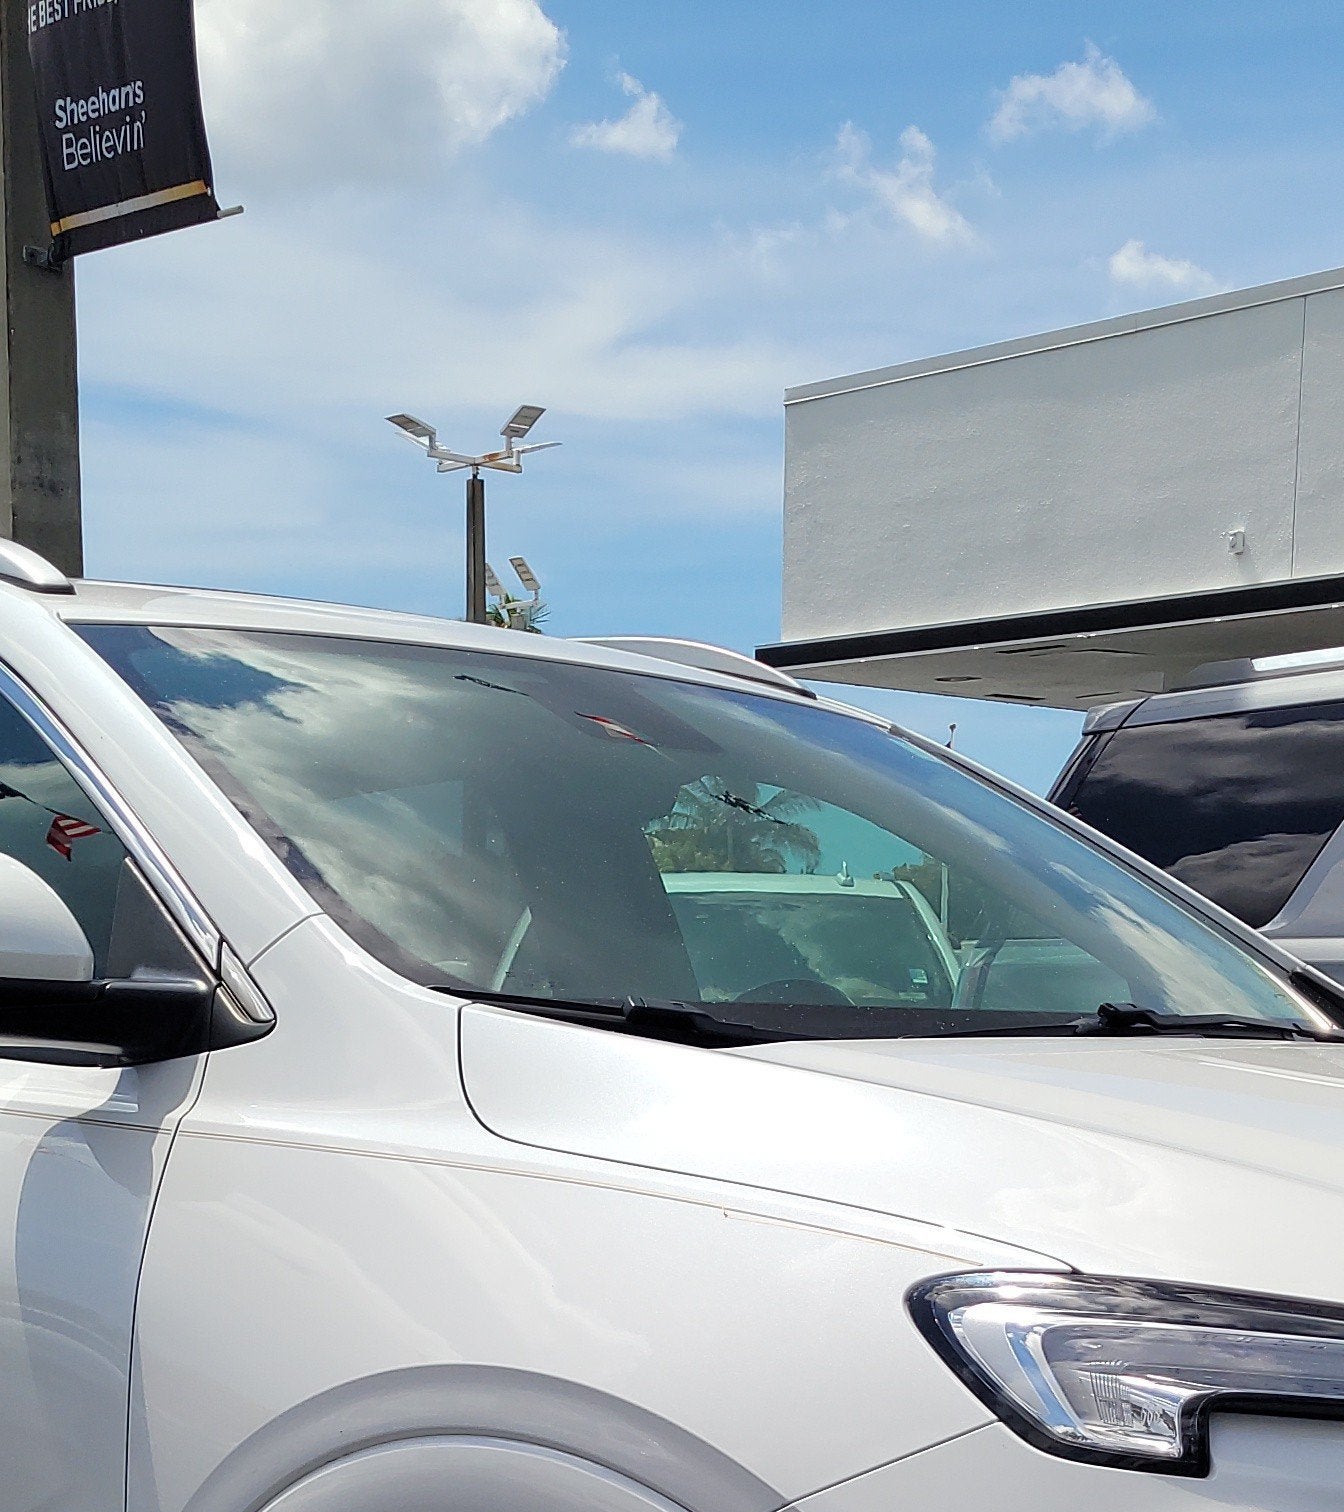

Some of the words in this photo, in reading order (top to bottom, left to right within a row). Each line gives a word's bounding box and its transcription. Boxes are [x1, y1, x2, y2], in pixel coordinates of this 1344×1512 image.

[39, 0, 69, 30] BEST
[55, 80, 144, 129] Sheehan's
[62, 110, 146, 171] Believin'
